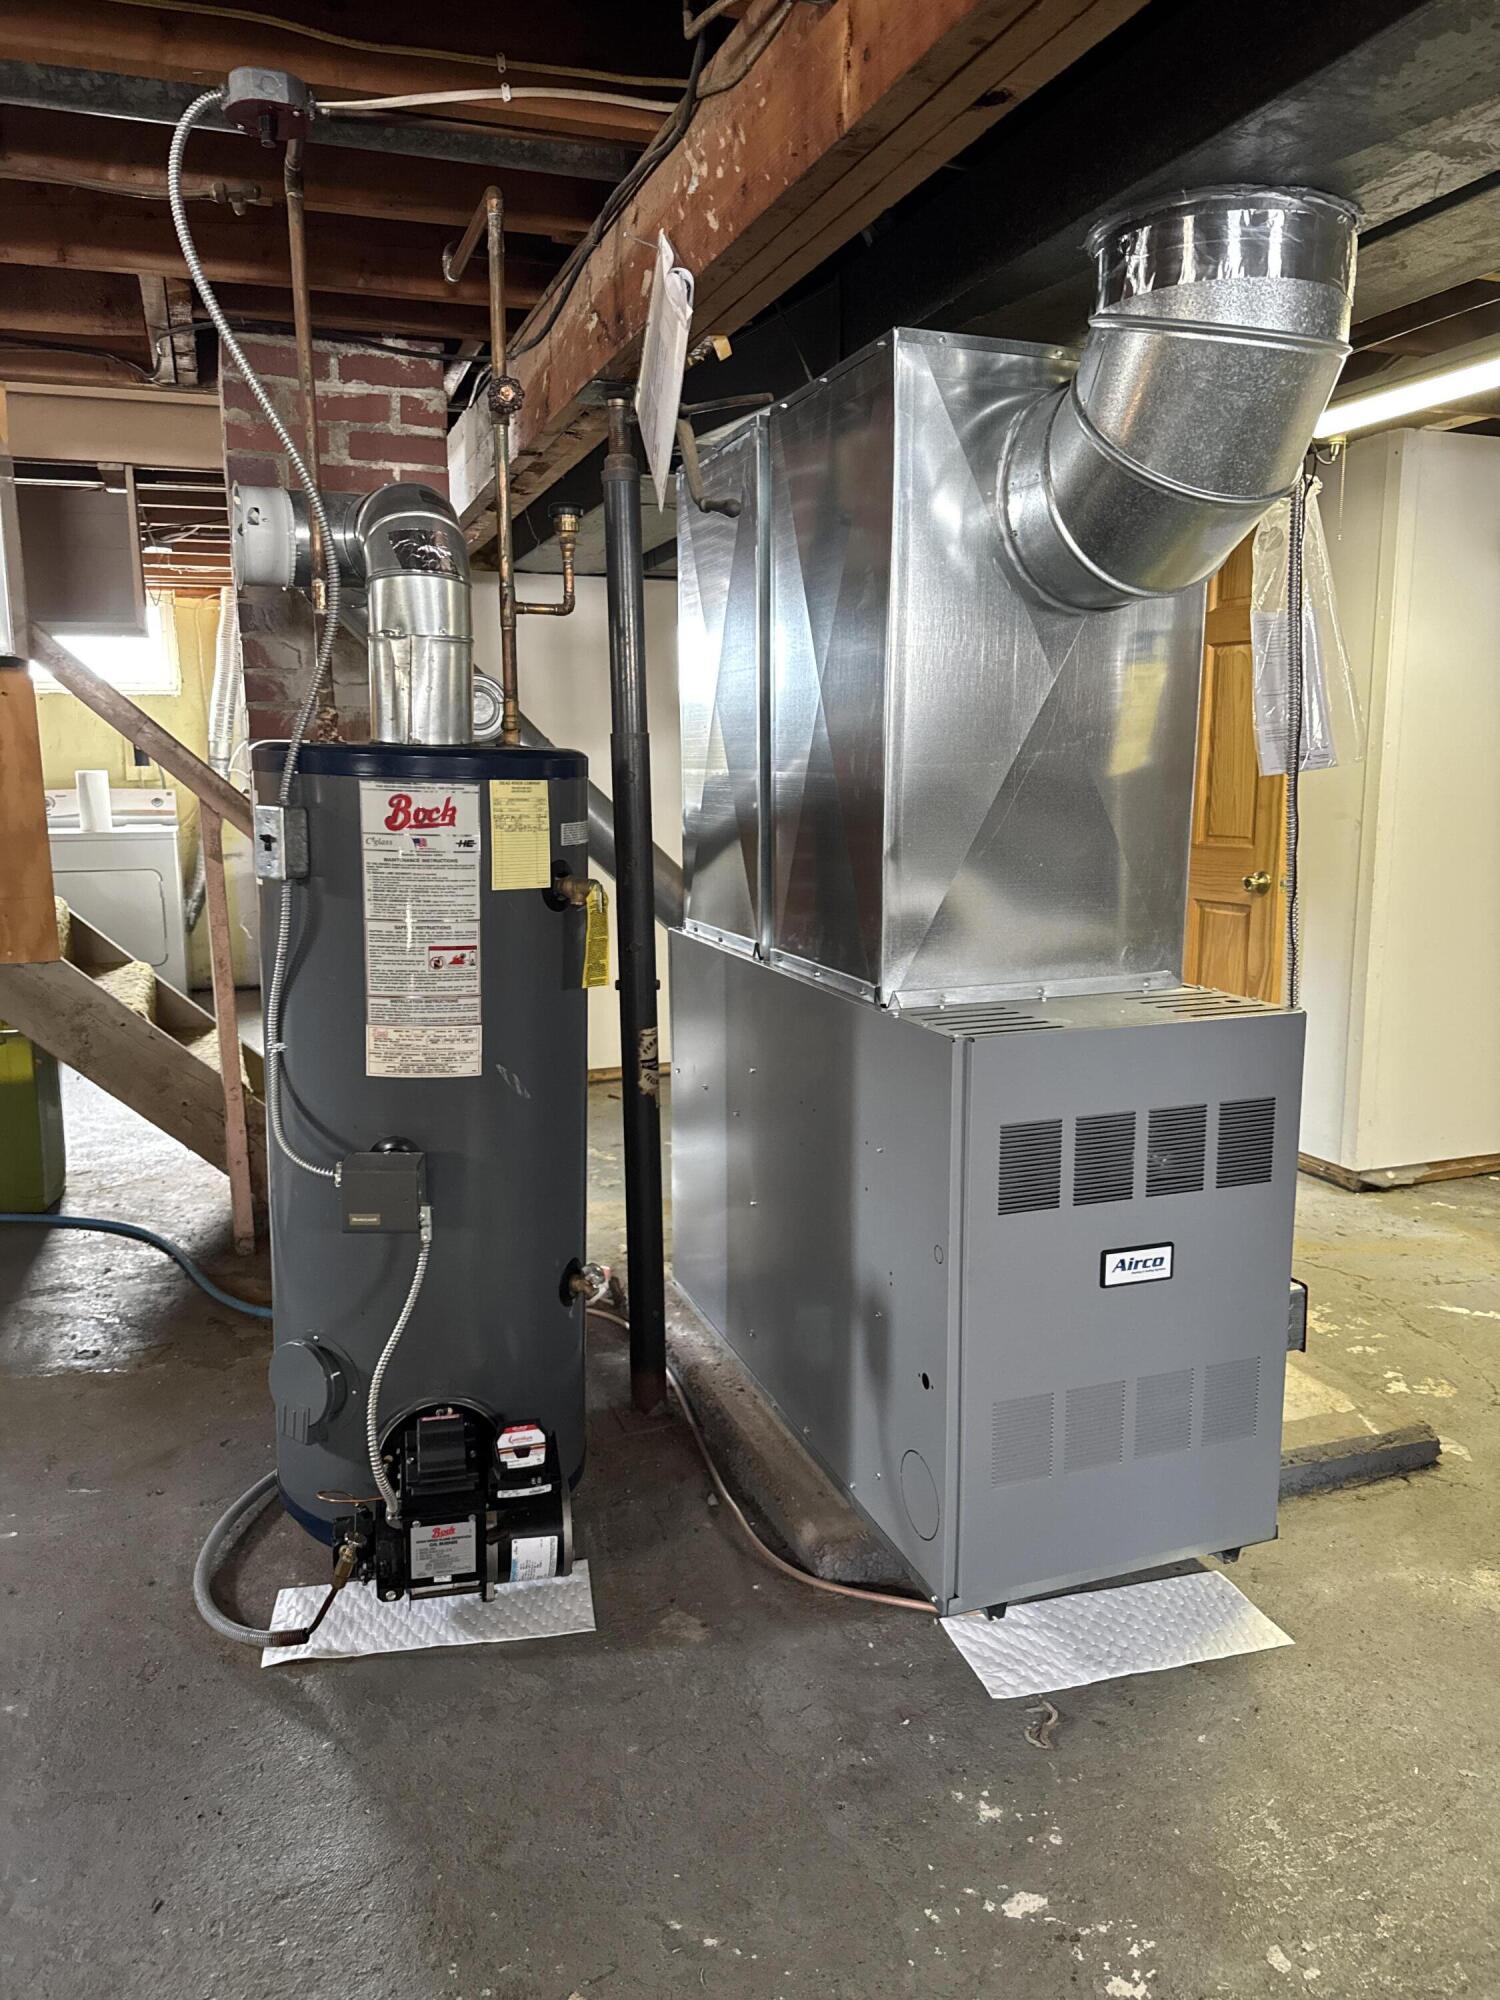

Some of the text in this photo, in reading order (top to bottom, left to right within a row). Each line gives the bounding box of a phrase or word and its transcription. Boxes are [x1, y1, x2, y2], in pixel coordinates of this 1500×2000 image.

[384, 793, 457, 831] Bock
[456, 839, 477, 848] HE
[1112, 1256, 1165, 1273] Airco
